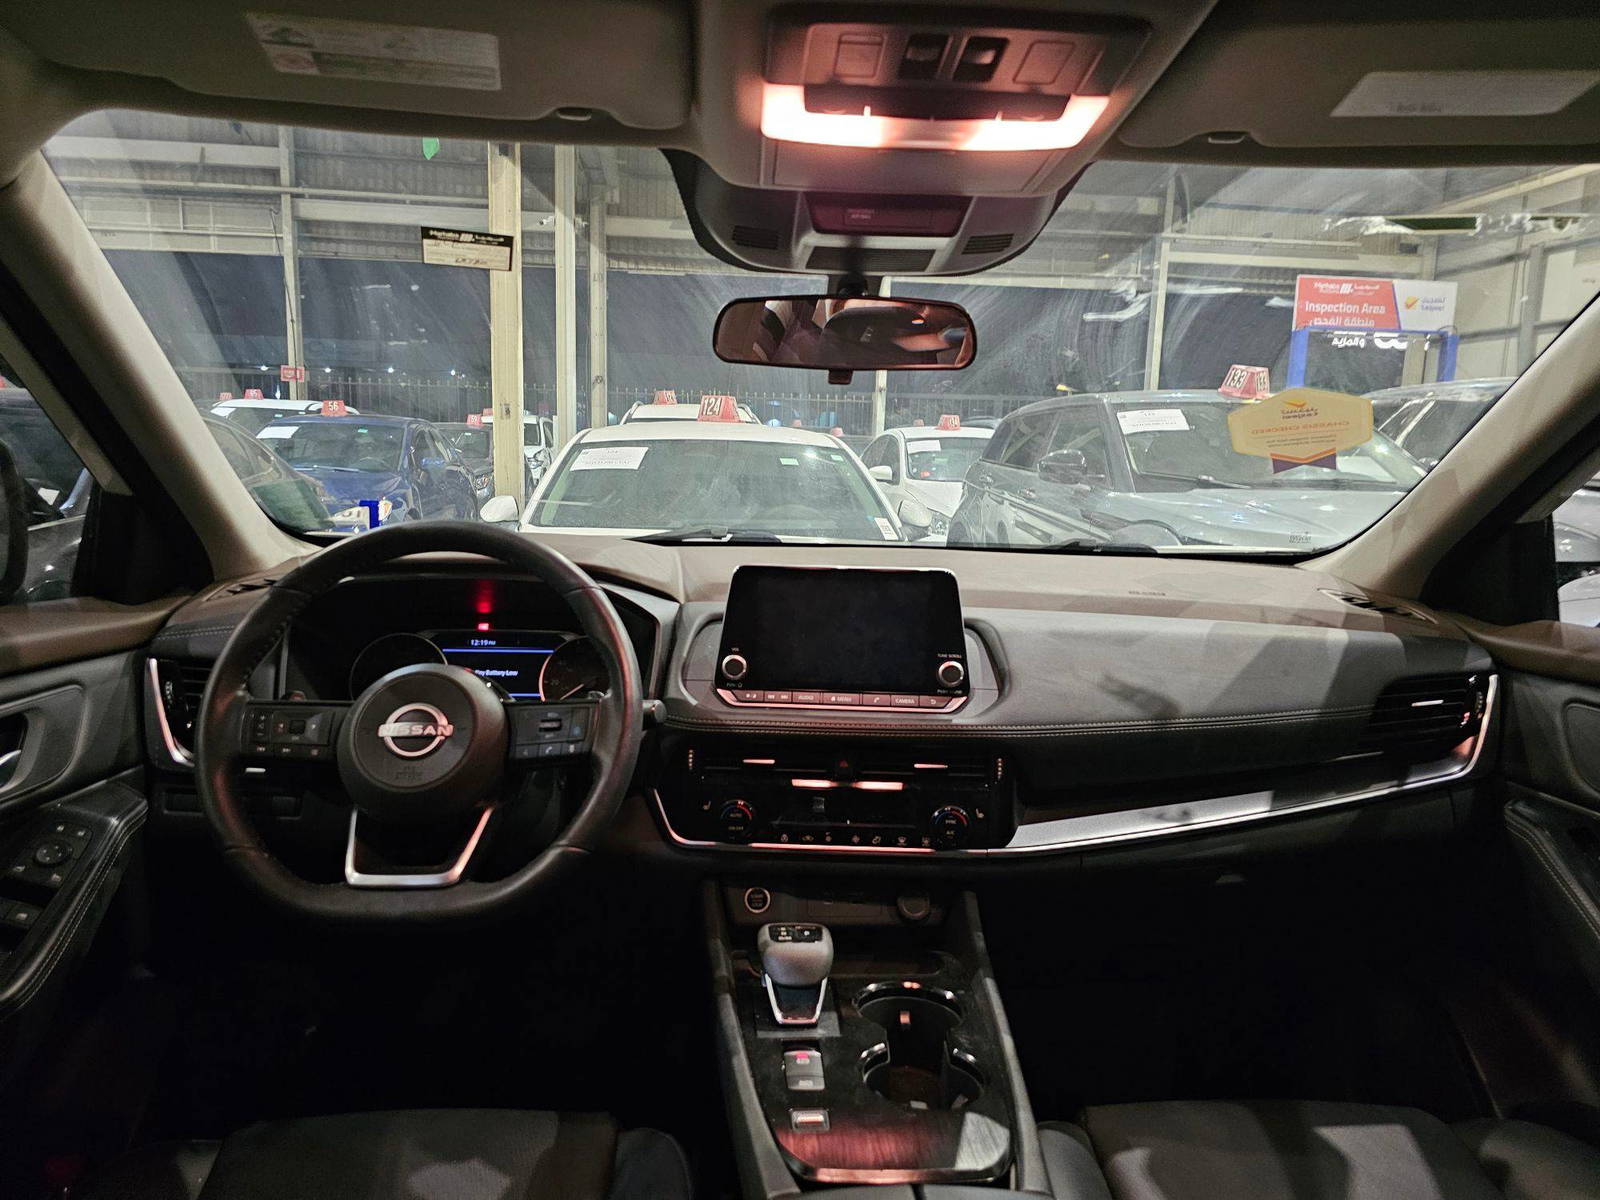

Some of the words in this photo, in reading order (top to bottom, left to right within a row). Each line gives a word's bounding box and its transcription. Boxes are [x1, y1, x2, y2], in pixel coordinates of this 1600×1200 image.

[1305, 301, 1359, 314] Inspection
[1361, 303, 1386, 313] Area
[1226, 369, 1248, 389] 133
[328, 401, 339, 411] 56
[703, 398, 722, 416] 124
[380, 723, 453, 737] NISSAN
